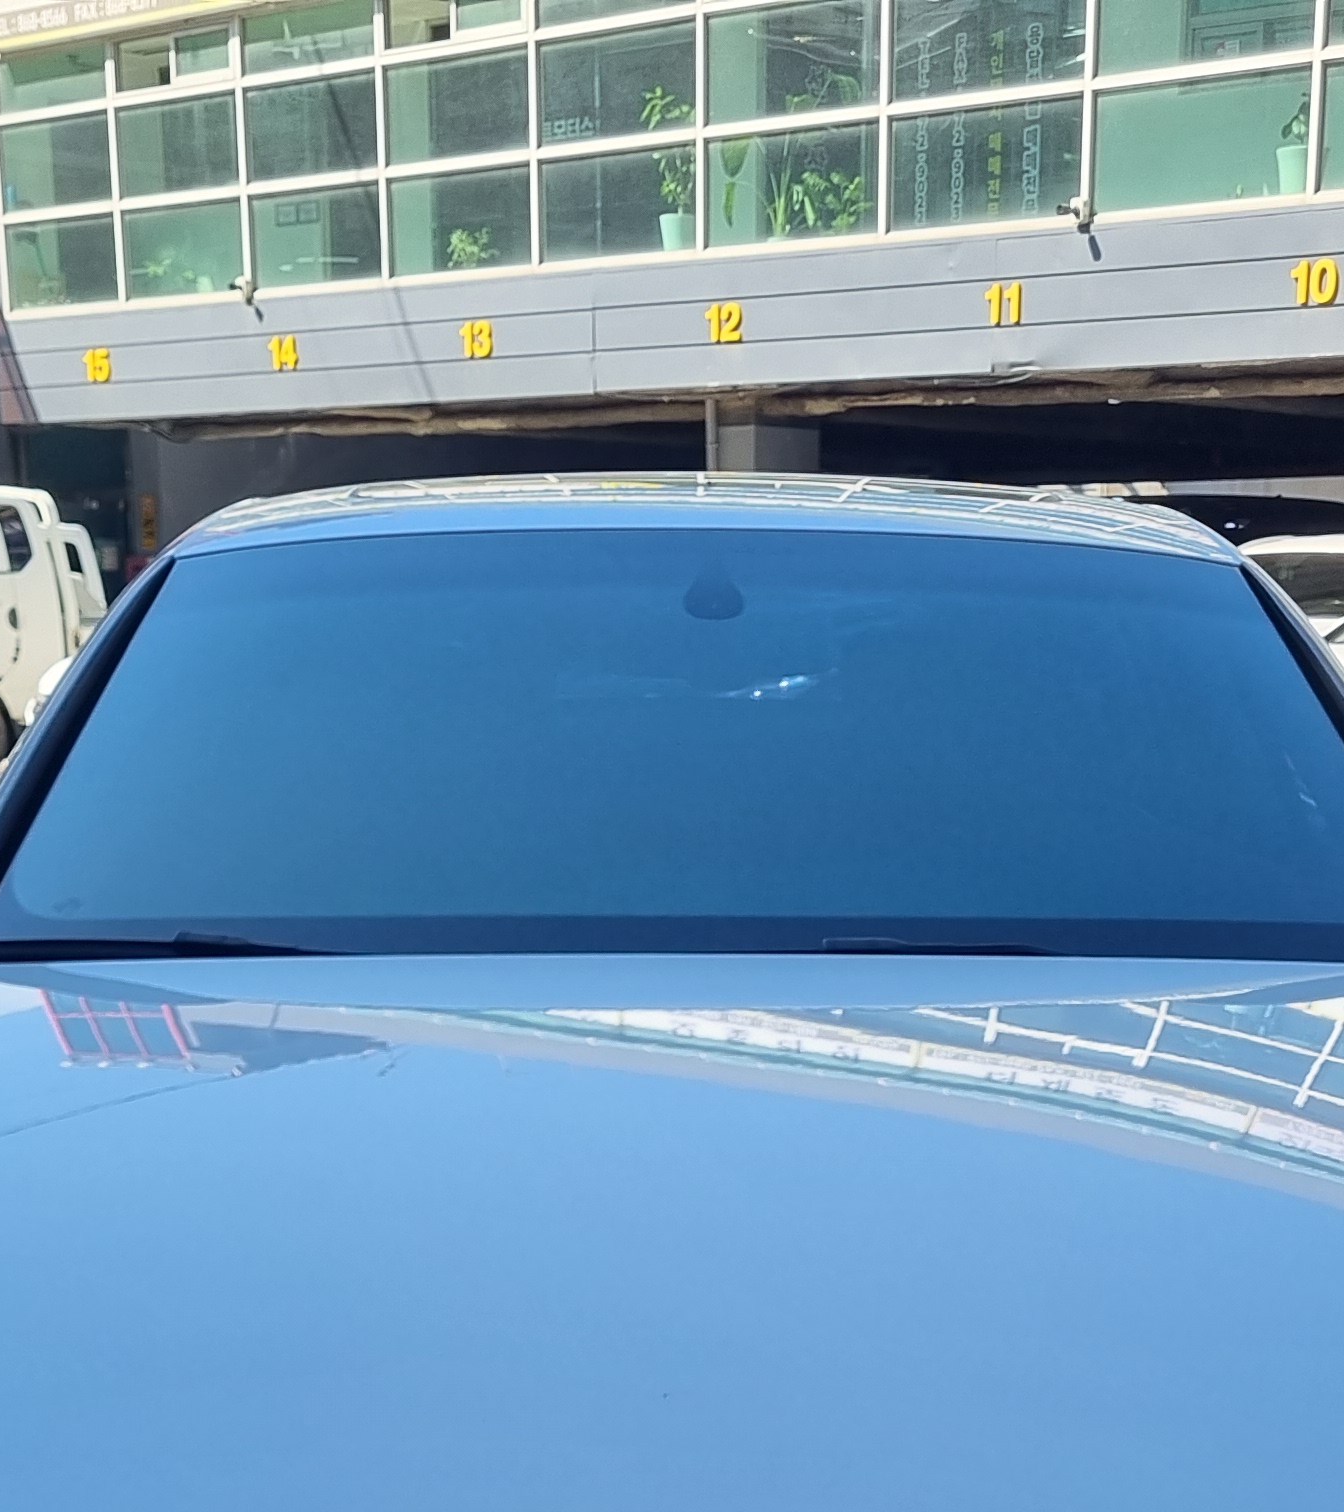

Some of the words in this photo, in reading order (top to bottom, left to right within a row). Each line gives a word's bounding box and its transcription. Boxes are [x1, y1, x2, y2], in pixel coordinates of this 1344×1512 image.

[1291, 258, 1340, 305] 10
[705, 302, 743, 343] 12
[985, 282, 1023, 326] 11
[268, 335, 298, 370] 14
[459, 319, 493, 358] 13
[83, 347, 111, 383] 15
